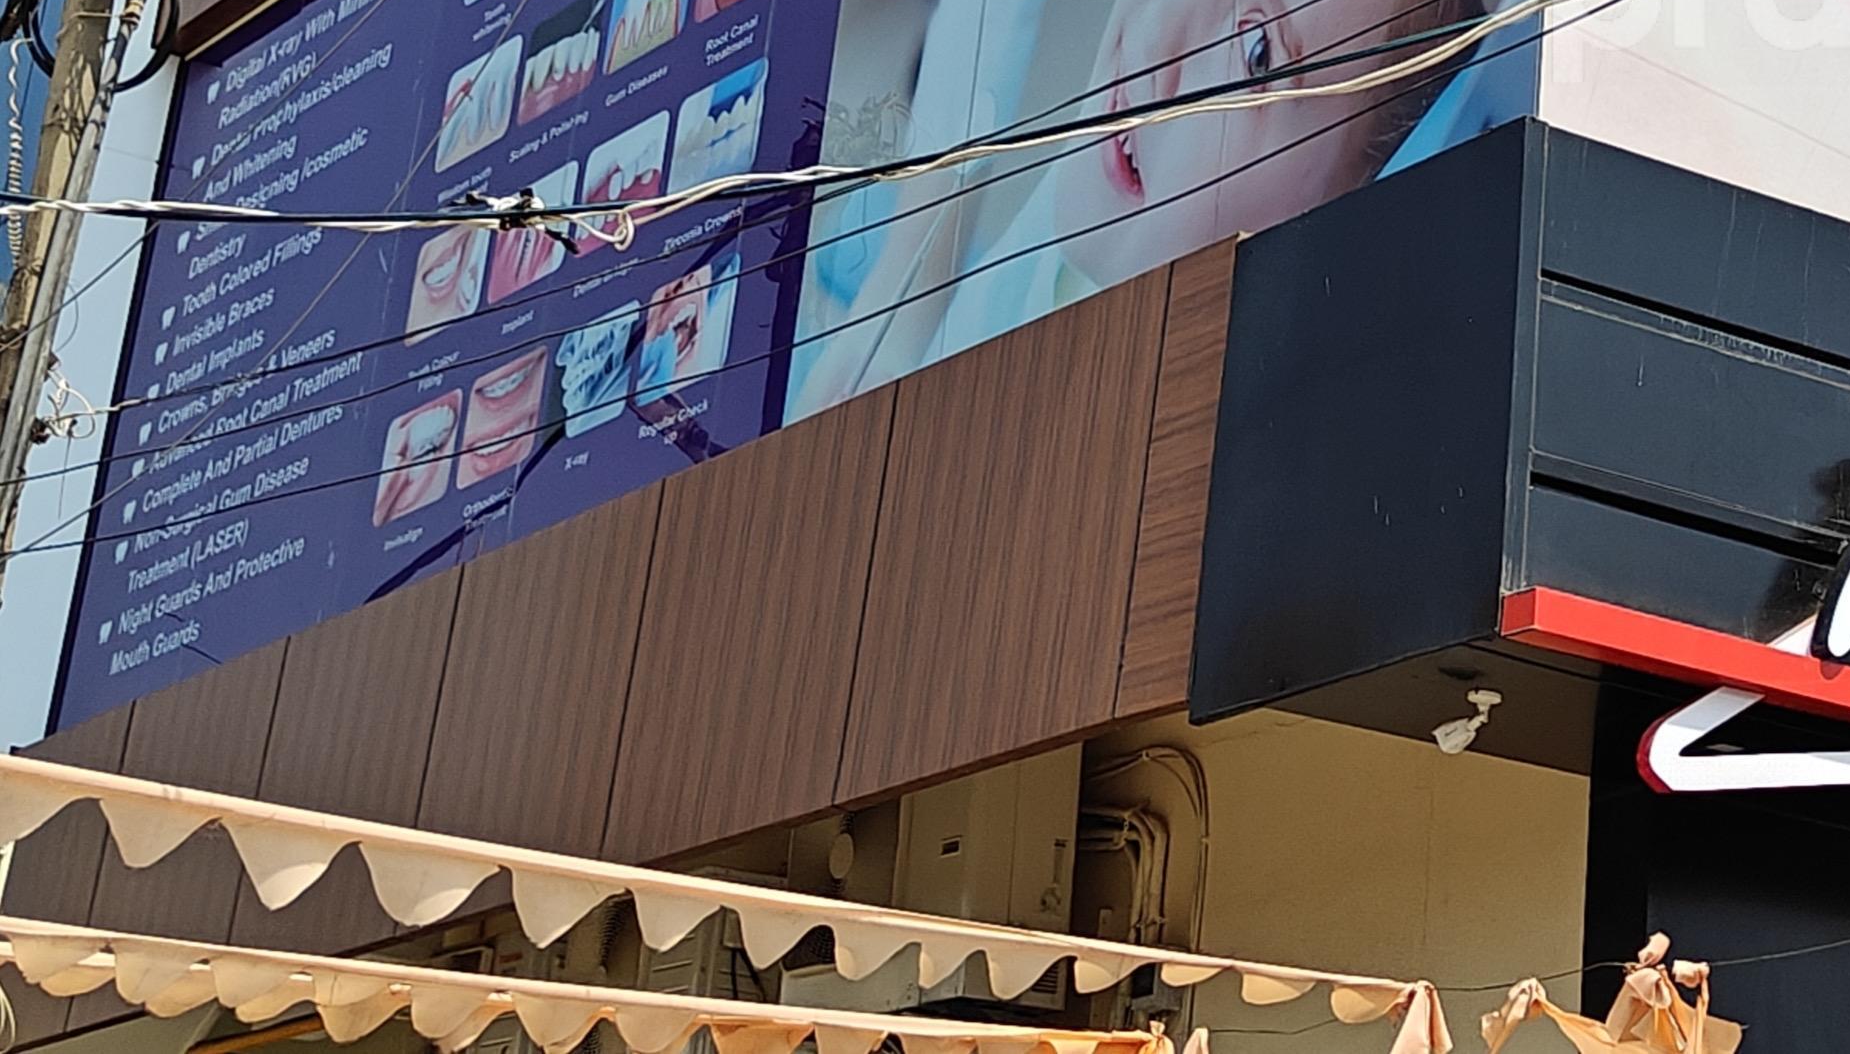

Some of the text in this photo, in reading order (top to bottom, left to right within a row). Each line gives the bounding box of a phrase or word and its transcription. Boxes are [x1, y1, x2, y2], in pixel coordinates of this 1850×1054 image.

[225, 55, 267, 93] Digital
[267, 31, 302, 67] X-ray
[304, 8, 336, 42] With
[705, 13, 760, 53] Root Canal
[705, 33, 754, 67] Treatment
[218, 51, 316, 130] Radiation(RVG)
[203, 134, 298, 202] And Whitening
[300, 126, 370, 183] /cosmetic
[182, 282, 217, 317] Tooth
[219, 249, 272, 296] Colored
[188, 233, 247, 280] Dentistry
[172, 288, 275, 357] Invisible Braces
[158, 396, 208, 434] Crowns,
[280, 329, 336, 368] Veneers
[165, 328, 265, 396] Dental Implants
[250, 385, 291, 424] Canal
[292, 350, 364, 402] Treatment
[142, 403, 343, 513] Complete And Partial Dentures
[218, 482, 252, 512] Gum
[253, 455, 311, 498] Disease
[117, 537, 306, 636] Night Guards And Protective
[128, 518, 250, 594] Treatment (LASER)
[108, 619, 201, 676] Mouth Guards
